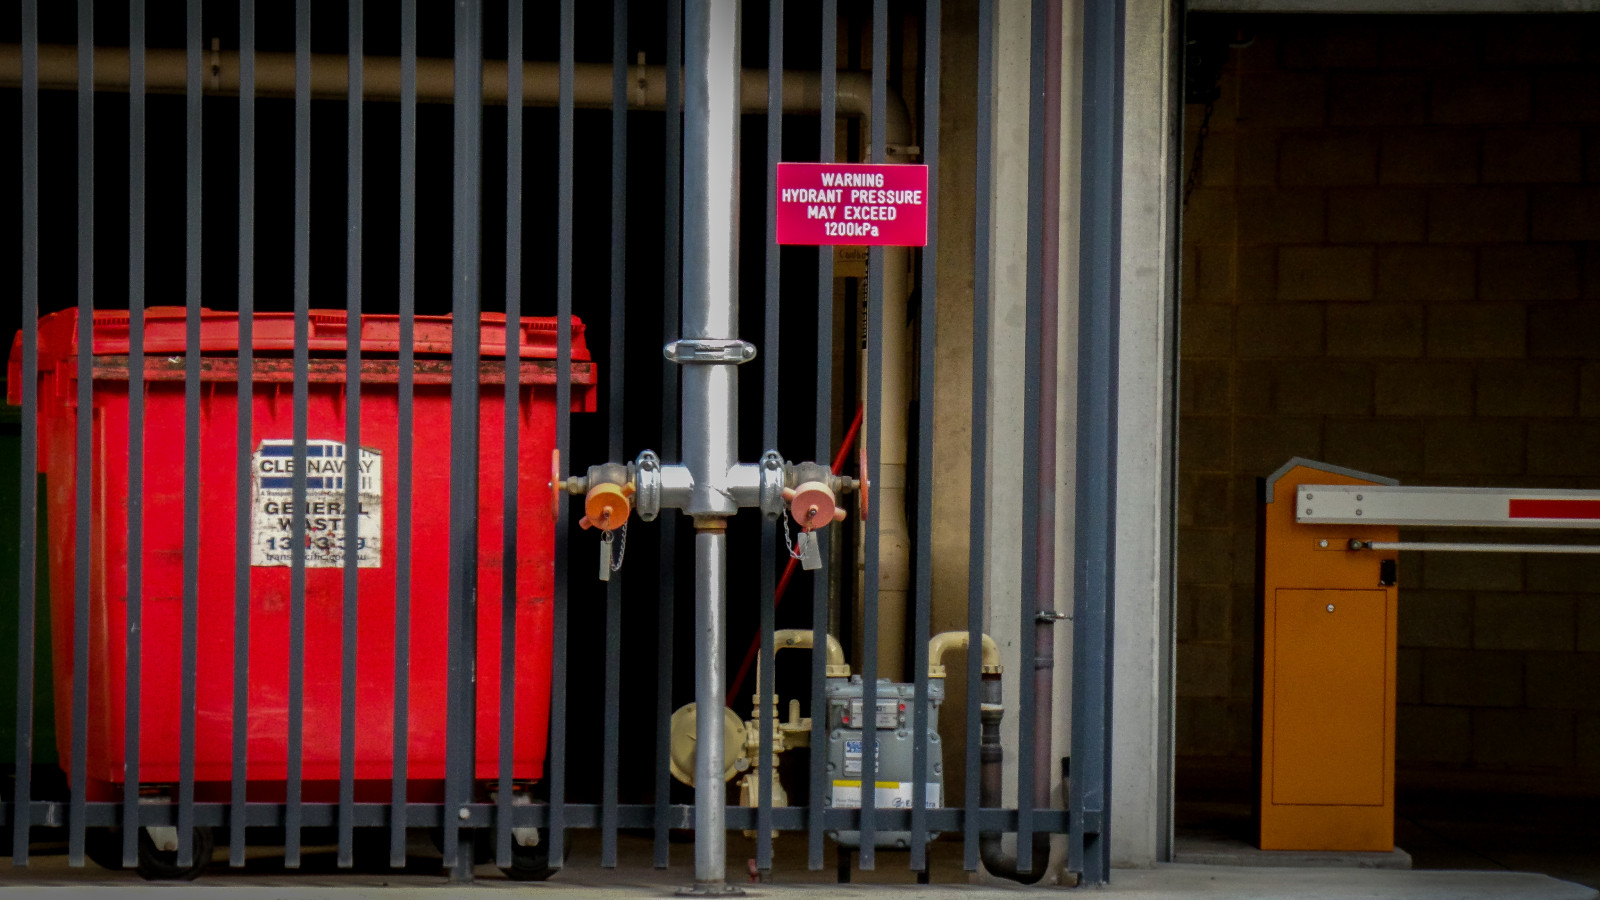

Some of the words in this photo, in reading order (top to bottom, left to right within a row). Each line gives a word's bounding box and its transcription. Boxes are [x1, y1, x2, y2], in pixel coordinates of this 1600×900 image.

[821, 172, 885, 188] WARNING
[781, 188, 844, 203] HYDRANT
[851, 189, 922, 205] PRESSURE
[807, 205, 836, 220] MAY
[844, 205, 897, 221] EXCEED
[824, 222, 879, 237] 1200kPa
[260, 459, 374, 474] CLENAWY
[264, 501, 369, 515] GEERL
[278, 517, 343, 531] WAST
